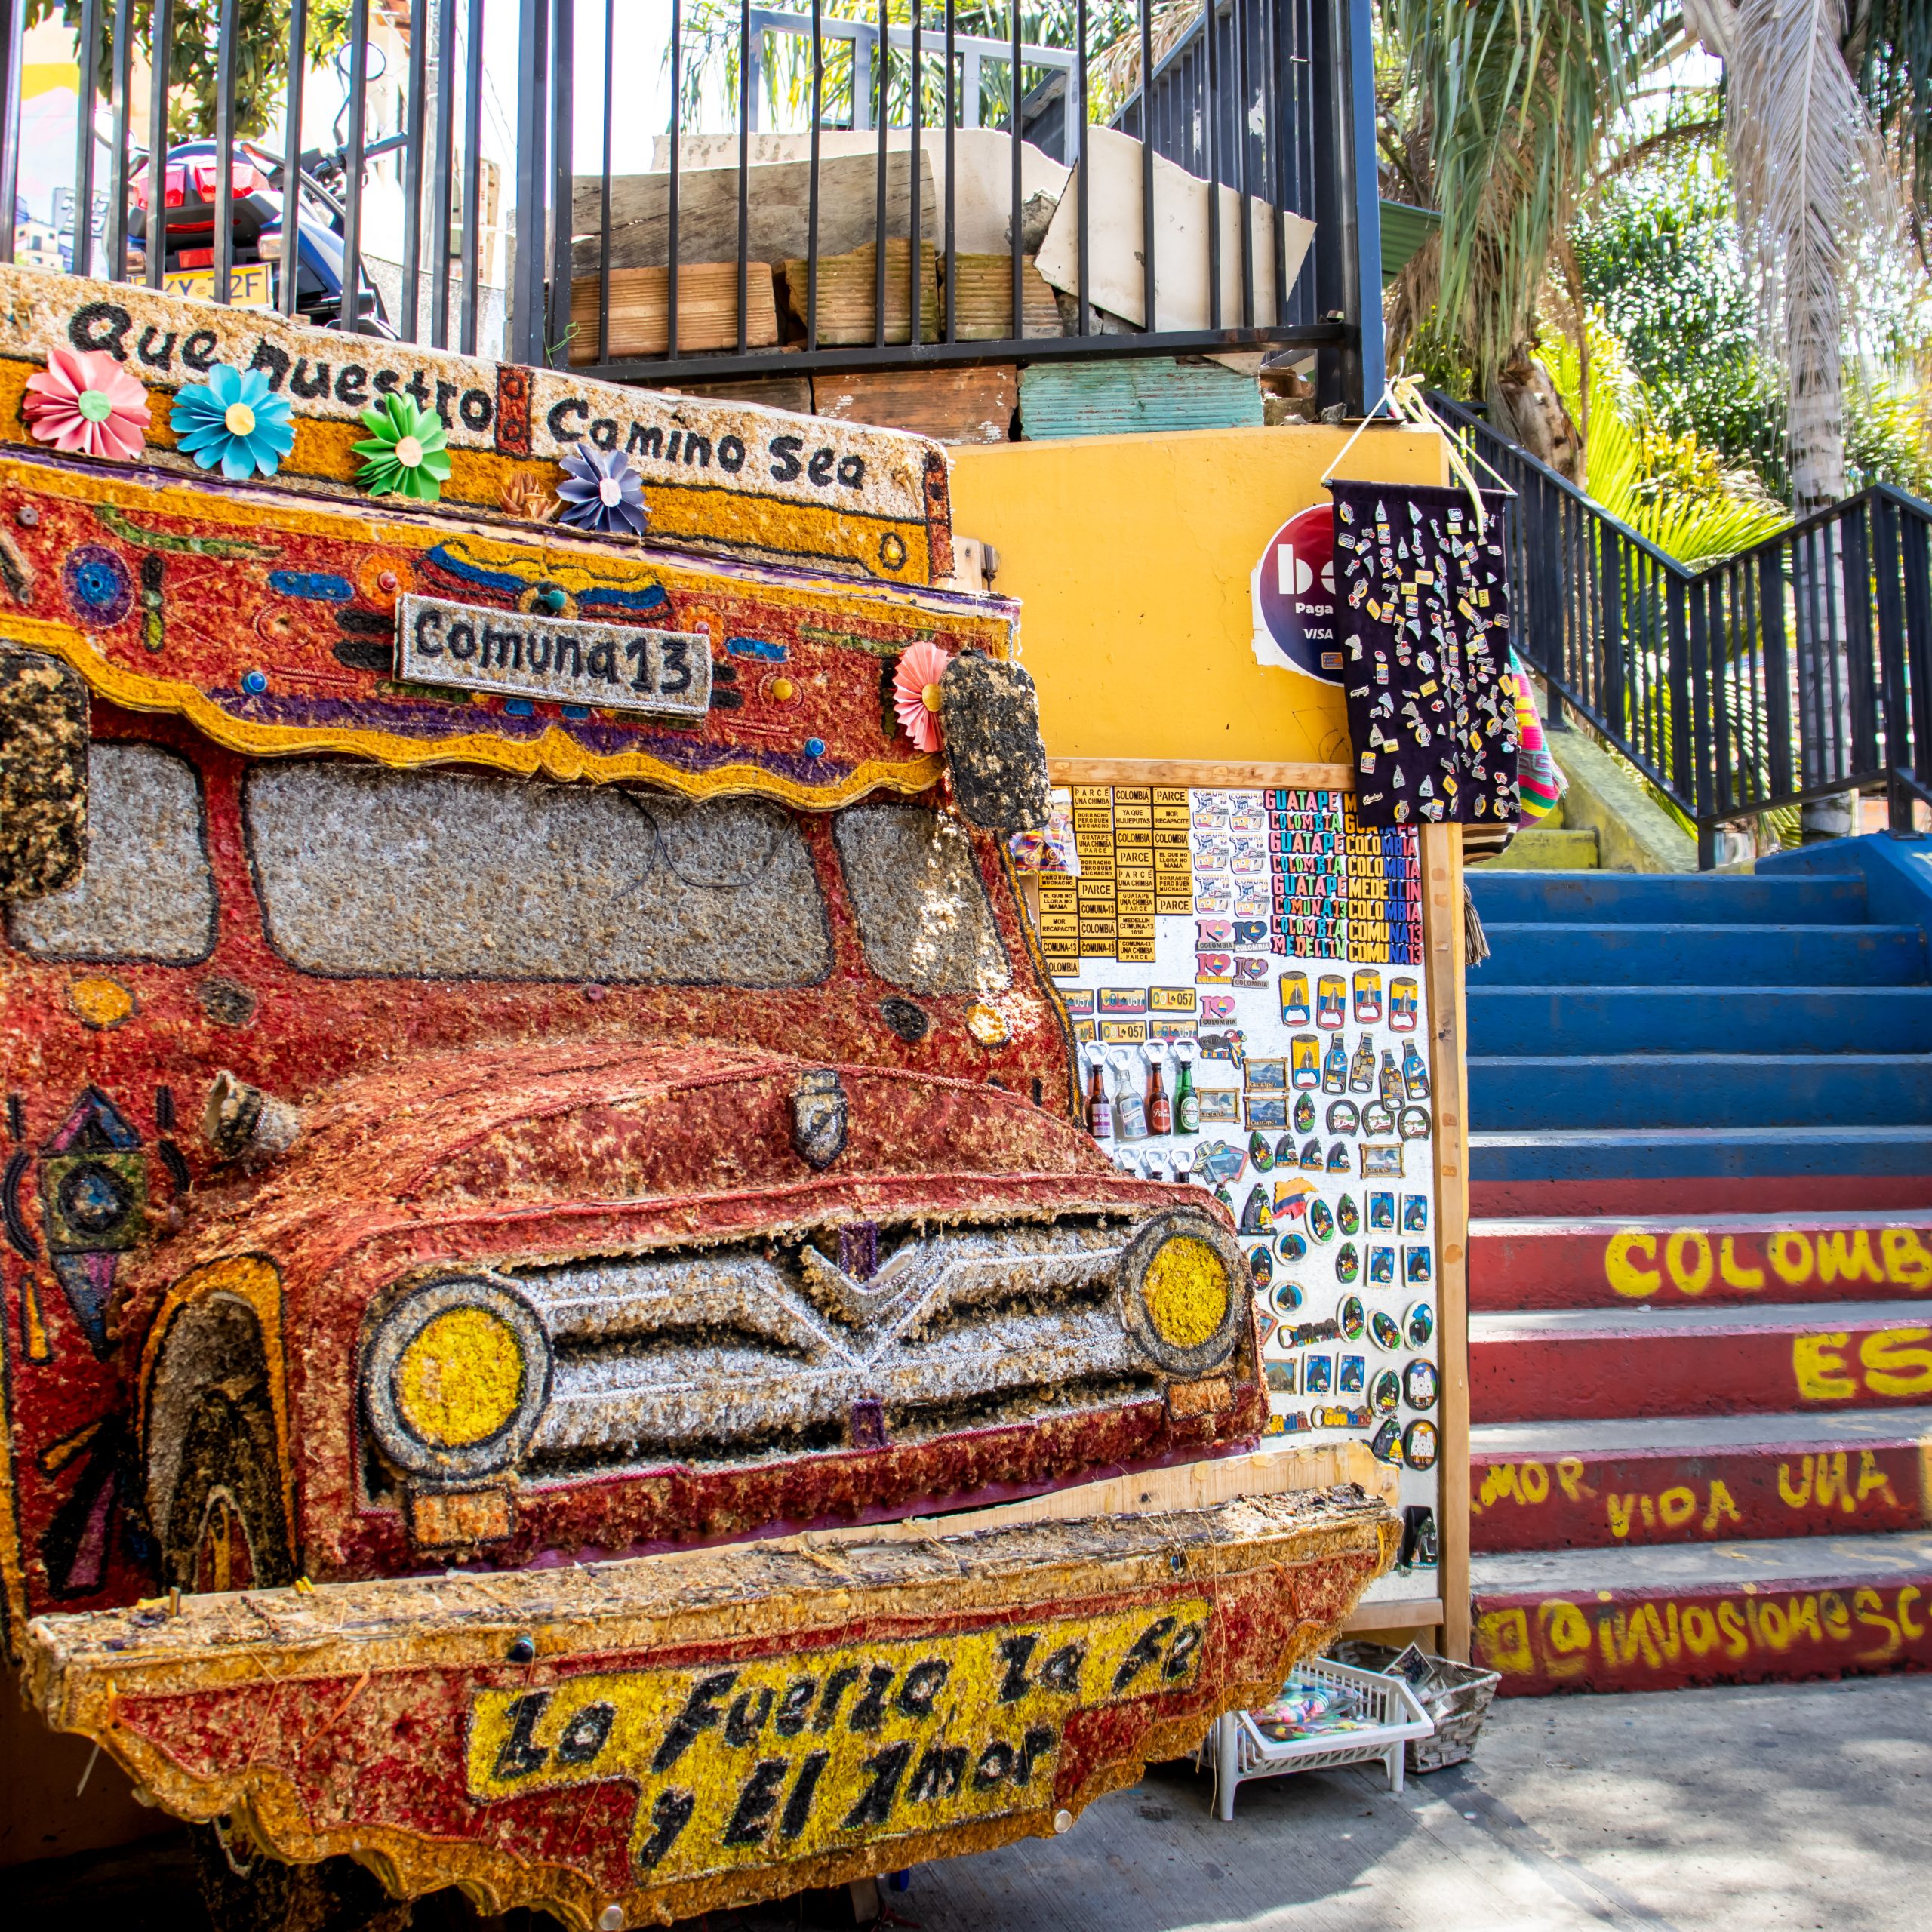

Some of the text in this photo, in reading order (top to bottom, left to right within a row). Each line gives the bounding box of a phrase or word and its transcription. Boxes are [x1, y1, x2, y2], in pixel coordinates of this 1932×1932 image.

[68, 301, 219, 373] Que
[547, 398, 746, 474] Camino
[768, 436, 866, 489] Sea
[1295, 603, 1333, 616] Paga
[1302, 629, 1333, 639] VISA
[1116, 790, 1149, 800] COLOMBIA
[1157, 792, 1185, 801] PARCE
[1265, 789, 1338, 811] GUATAPE
[1270, 812, 1342, 832] COLOMBIA
[1118, 833, 1150, 842] COLOMBIA
[1155, 833, 1188, 844] COLOMBIA
[1270, 832, 1343, 854] GUATAPE
[1346, 835, 1417, 856] COLOMBIA
[1121, 853, 1149, 862] PARCE
[1272, 855, 1344, 875] COLOMBIA
[1348, 857, 1420, 878] COLOMBIA
[1082, 885, 1111, 894] PARCE
[1273, 875, 1346, 897] GUATAPE
[1349, 878, 1421, 900] MEDELLIN
[1081, 905, 1114, 914] COMUNA-13
[1161, 900, 1189, 910] PARCE
[1348, 900, 1420, 921] COLOMBIA
[1081, 924, 1115, 934] COLOMBIA
[1273, 915, 1344, 939] COLOMBIA
[1044, 943, 1077, 952] COMUNA-13
[1081, 943, 1115, 952] COMUNA-13
[1235, 943, 1269, 952] COLOMBIA
[1272, 936, 1346, 959] MEDELLIN
[1048, 963, 1077, 972] OLOMBIA
[1177, 993, 1193, 1005] 057
[1128, 1026, 1143, 1038] 057
[1471, 1455, 1597, 1515] MOR
[1607, 1480, 1741, 1537] VIDA
